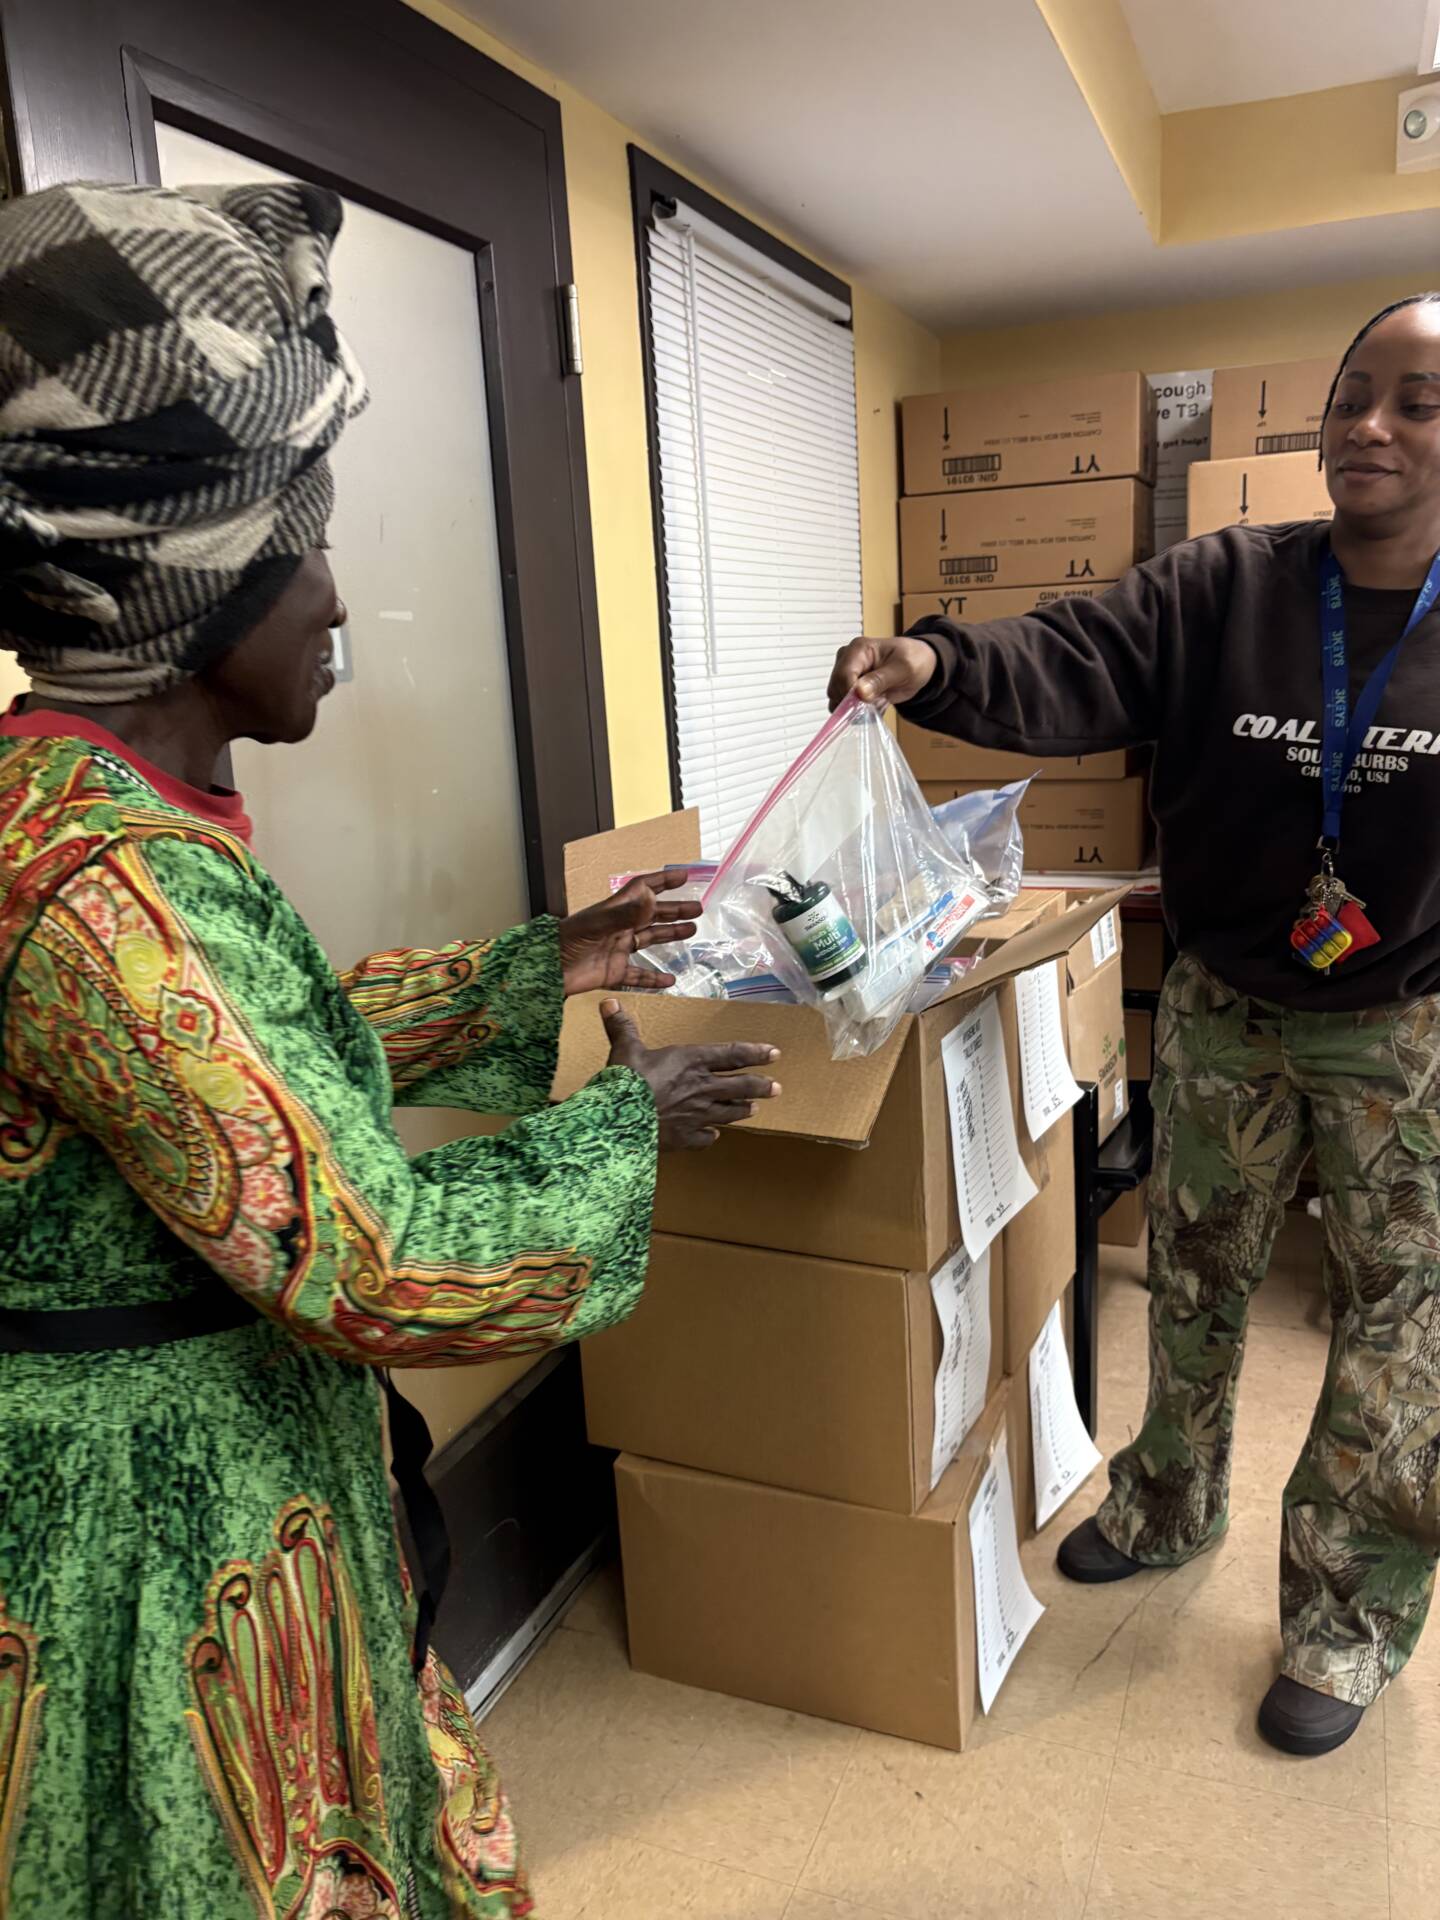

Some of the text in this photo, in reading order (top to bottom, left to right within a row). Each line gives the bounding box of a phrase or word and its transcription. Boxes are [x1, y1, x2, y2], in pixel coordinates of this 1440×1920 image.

[1154, 381, 1205, 399] cough
[1070, 453, 1100, 474] YT
[1065, 558, 1095, 578] YT
[938, 597, 968, 615] YT
[1333, 688, 1347, 728] 3KEYS
[1073, 846, 1104, 864] YT
